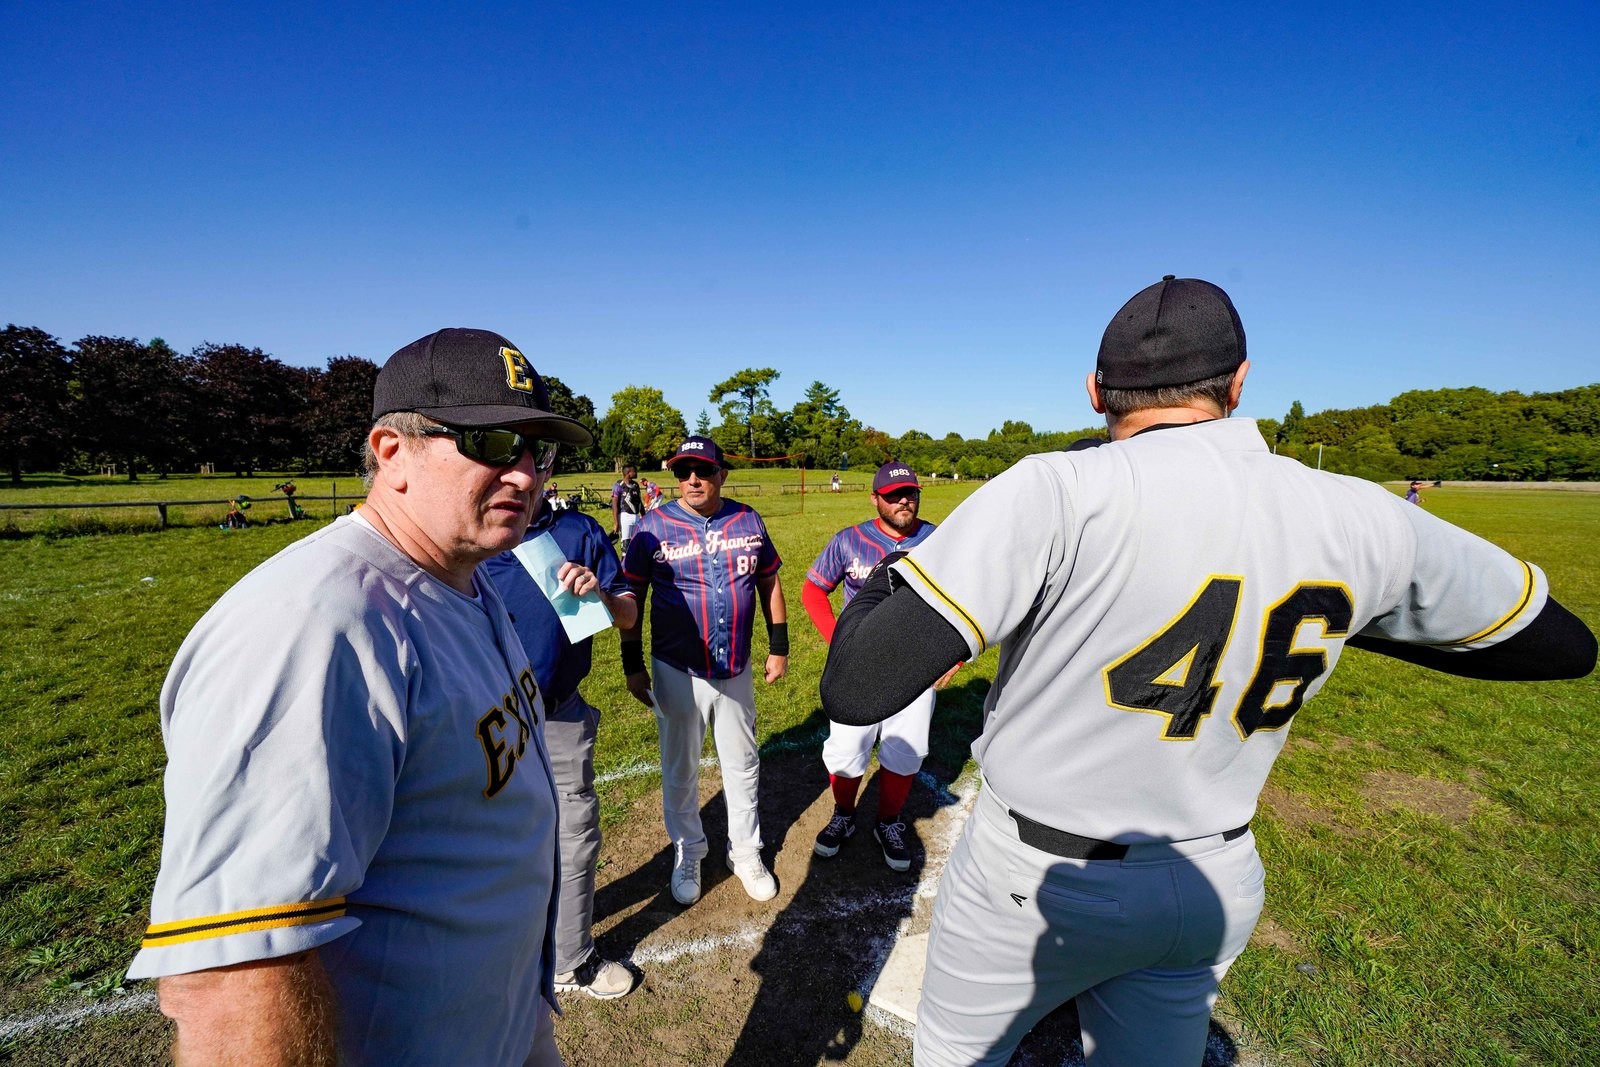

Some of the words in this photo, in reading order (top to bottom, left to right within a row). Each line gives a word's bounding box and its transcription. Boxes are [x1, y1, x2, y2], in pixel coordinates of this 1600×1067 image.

[499, 346, 533, 394] E
[681, 441, 704, 452] 1883
[889, 468, 910, 478] 1883
[653, 539, 704, 563] Stade
[1103, 574, 1355, 742] 46
